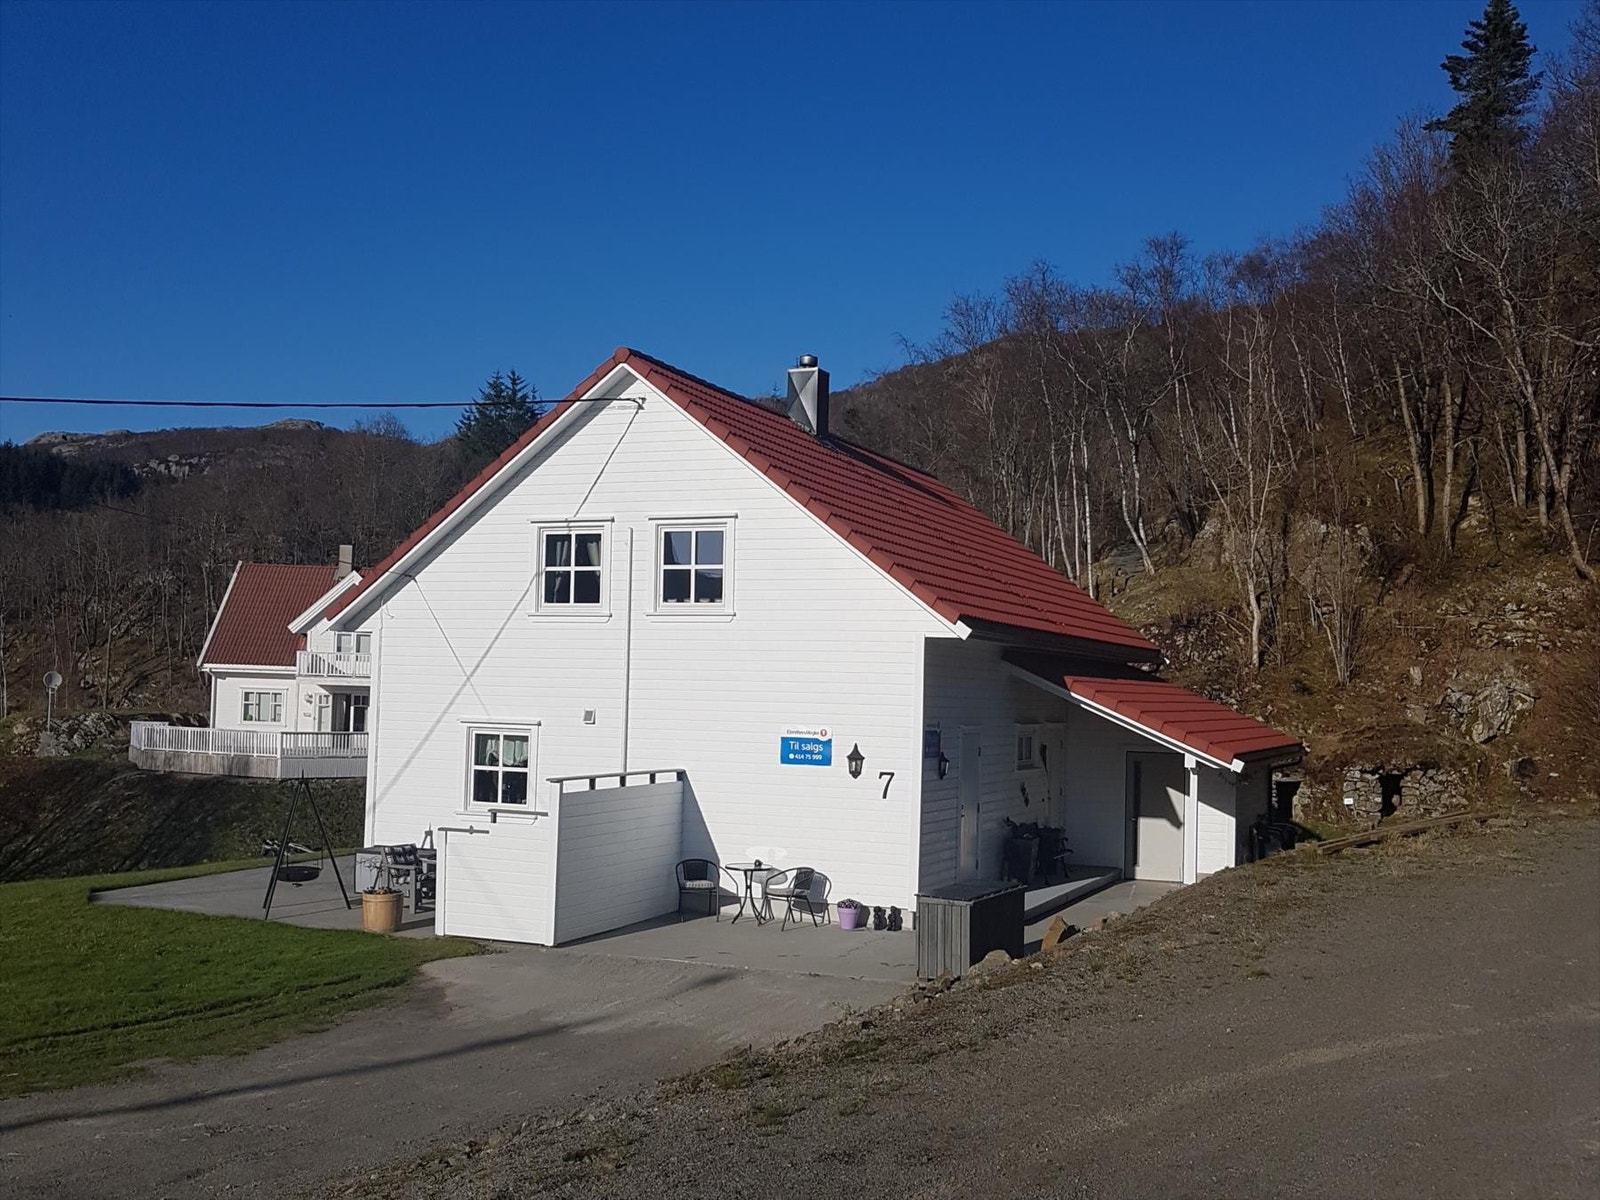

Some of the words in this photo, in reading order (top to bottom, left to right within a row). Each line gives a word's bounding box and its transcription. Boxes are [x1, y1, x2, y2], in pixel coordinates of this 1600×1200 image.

[789, 741, 799, 750] Til
[801, 742, 823, 753] salgs
[878, 771, 895, 799] 7
